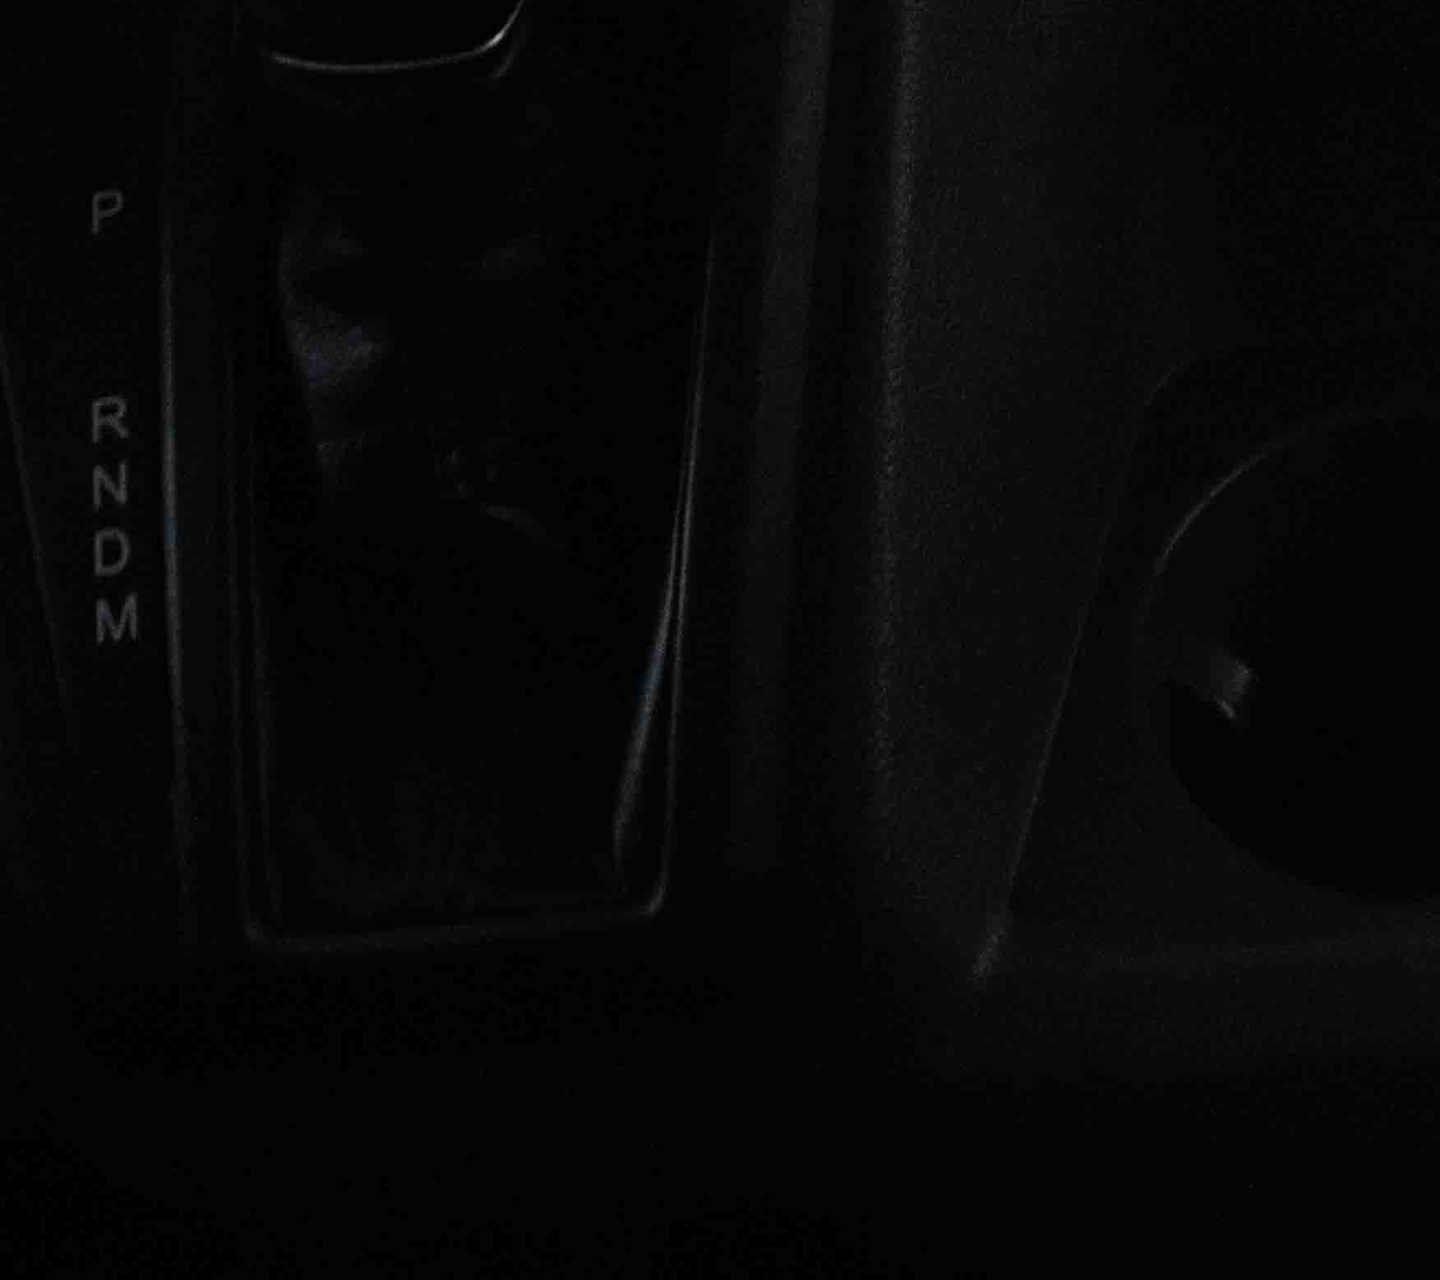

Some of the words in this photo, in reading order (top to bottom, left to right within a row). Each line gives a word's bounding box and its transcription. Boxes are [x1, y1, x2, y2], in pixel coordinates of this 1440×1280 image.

[92, 192, 123, 234] P
[92, 397, 128, 443] R
[93, 463, 127, 508] N
[95, 529, 130, 576] D
[96, 594, 137, 642] M
